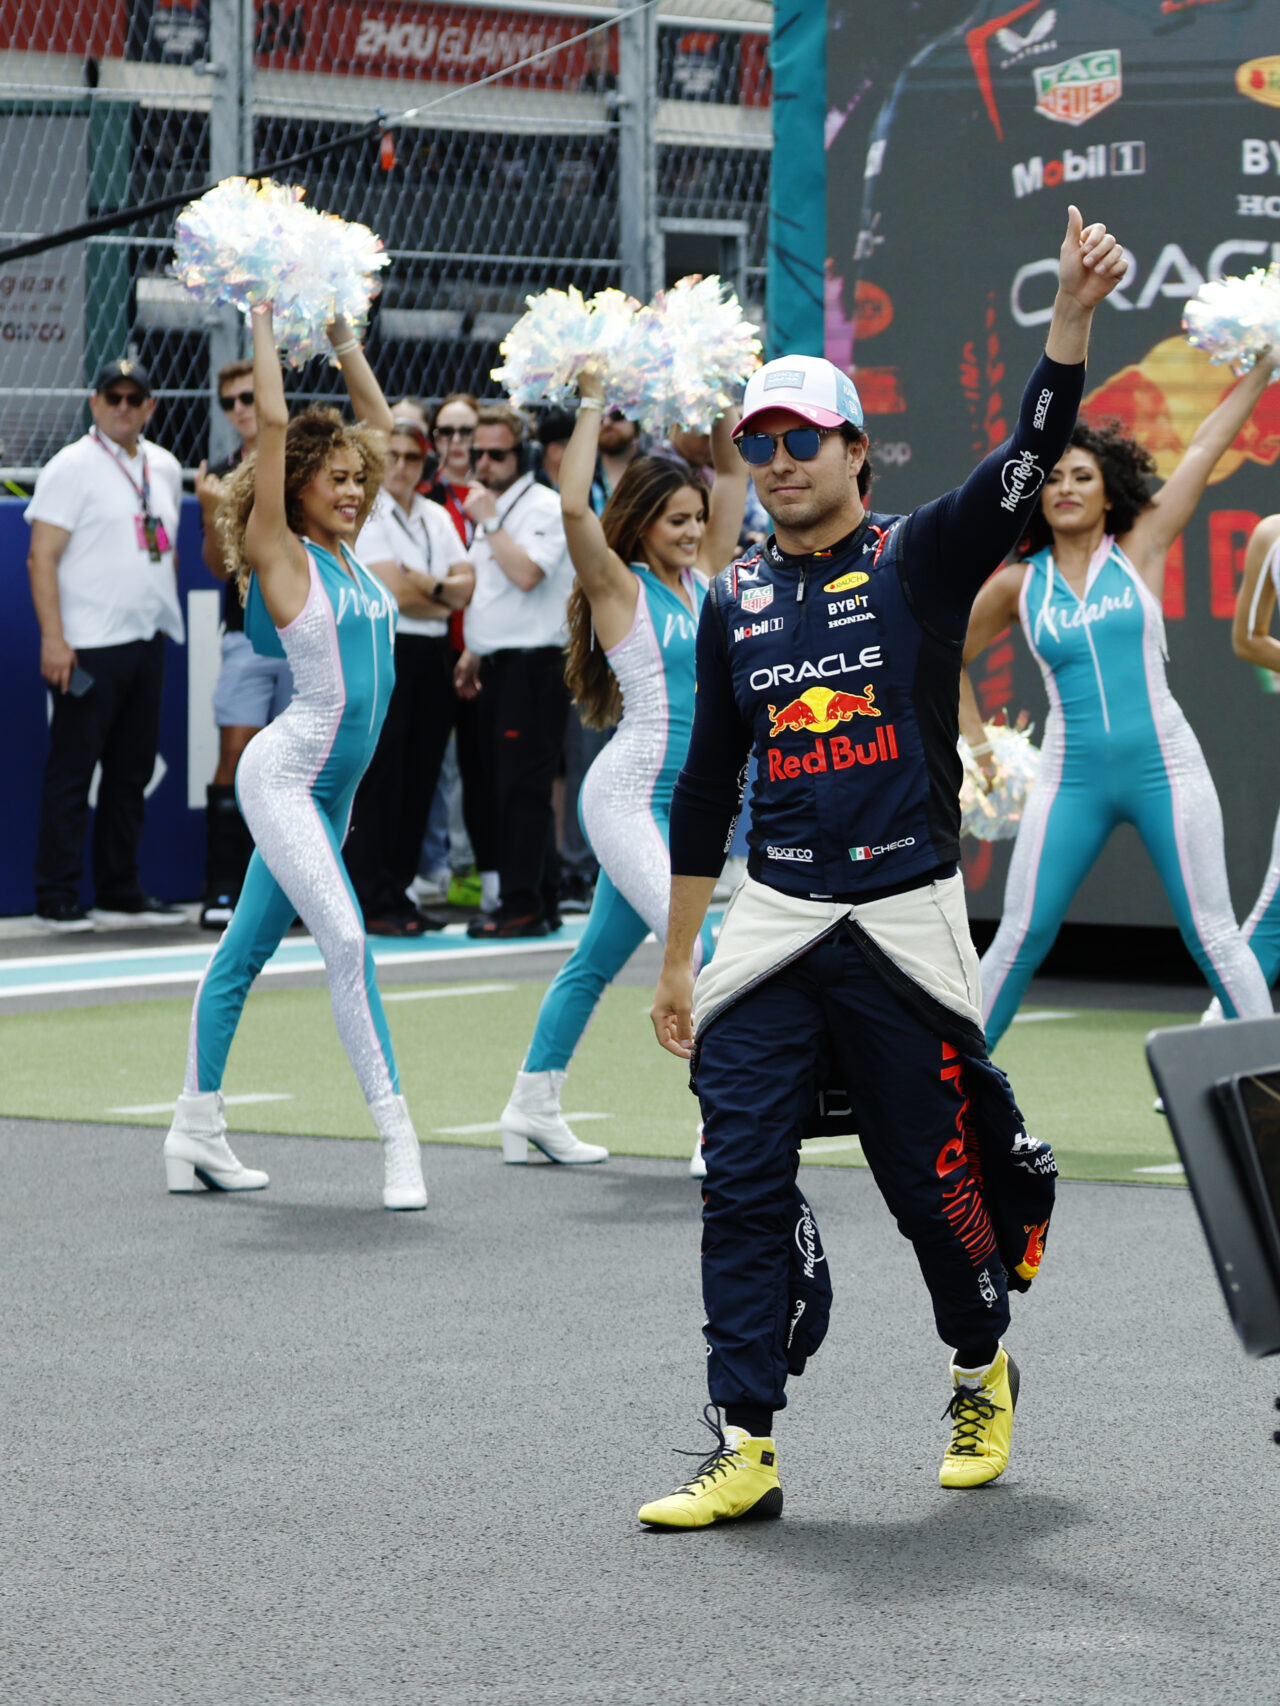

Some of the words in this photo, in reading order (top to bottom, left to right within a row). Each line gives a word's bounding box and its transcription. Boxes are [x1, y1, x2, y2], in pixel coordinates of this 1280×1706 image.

[354, 18, 437, 61] ZHOU
[1042, 55, 1113, 85] TAG
[1044, 82, 1117, 118] HEUER
[1011, 144, 1107, 199] Mobil
[1033, 388, 1054, 431] sparco
[1012, 450, 1039, 481] Rock
[1000, 475, 1025, 512] Hard
[747, 587, 771, 599] TAG
[836, 575, 863, 589] RAUCH
[743, 596, 773, 609] HEUER
[827, 594, 869, 616] BYBIT
[733, 620, 769, 643] Mobil
[828, 612, 876, 629] HONDA
[750, 645, 884, 691] ORACLE
[767, 738, 828, 783] Red
[829, 724, 899, 771] Bull
[767, 845, 814, 863] sparco
[871, 836, 916, 856] CHECO
[800, 1203, 816, 1238] Rock
[803, 1237, 816, 1279] Hard
